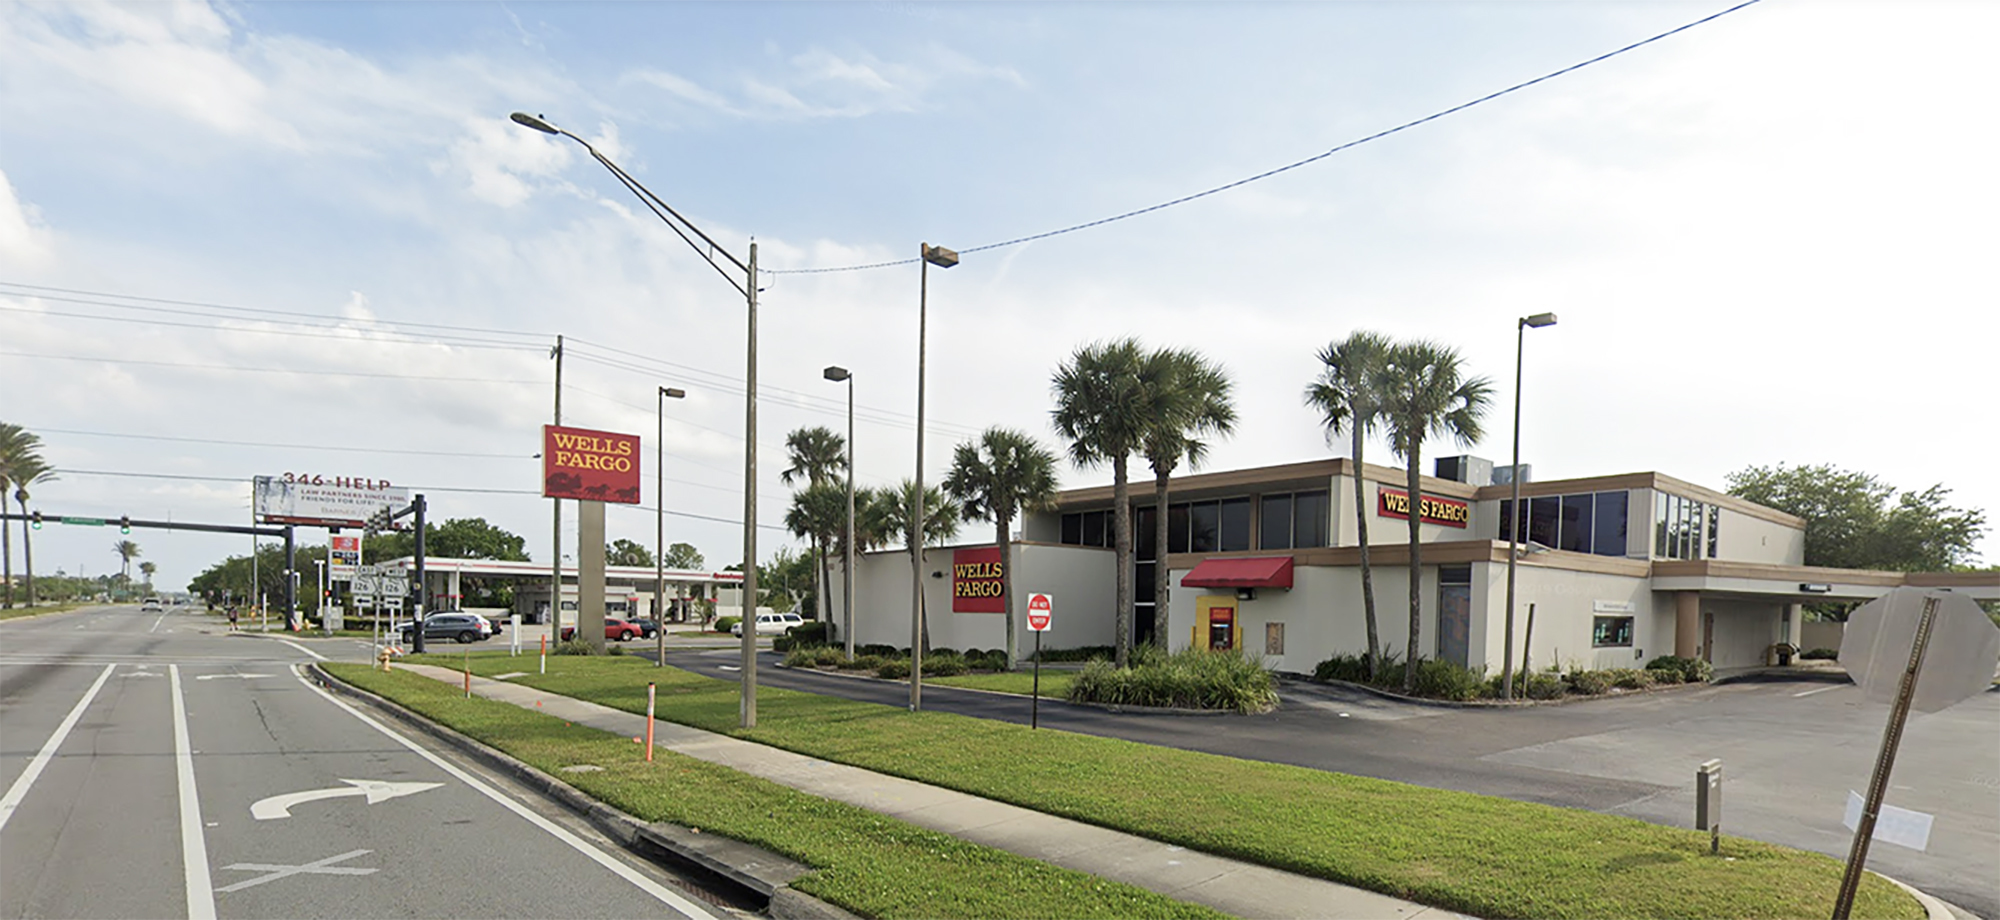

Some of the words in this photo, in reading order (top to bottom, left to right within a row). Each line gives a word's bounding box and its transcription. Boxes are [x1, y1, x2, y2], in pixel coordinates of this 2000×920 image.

[552, 433, 632, 456] WELLS
[555, 450, 631, 472] FARGO
[283, 471, 391, 491] 346-HELP
[301, 495, 337, 504] FRIENDS
[338, 497, 354, 505] FOR
[321, 490, 363, 499] PARTNERS
[364, 493, 387, 501] SINCE
[1430, 501, 1470, 522] FARGO
[954, 562, 1003, 578] WELLS
[354, 582, 368, 591] 126
[385, 584, 399, 593] 126
[955, 581, 1003, 597] FARGO
